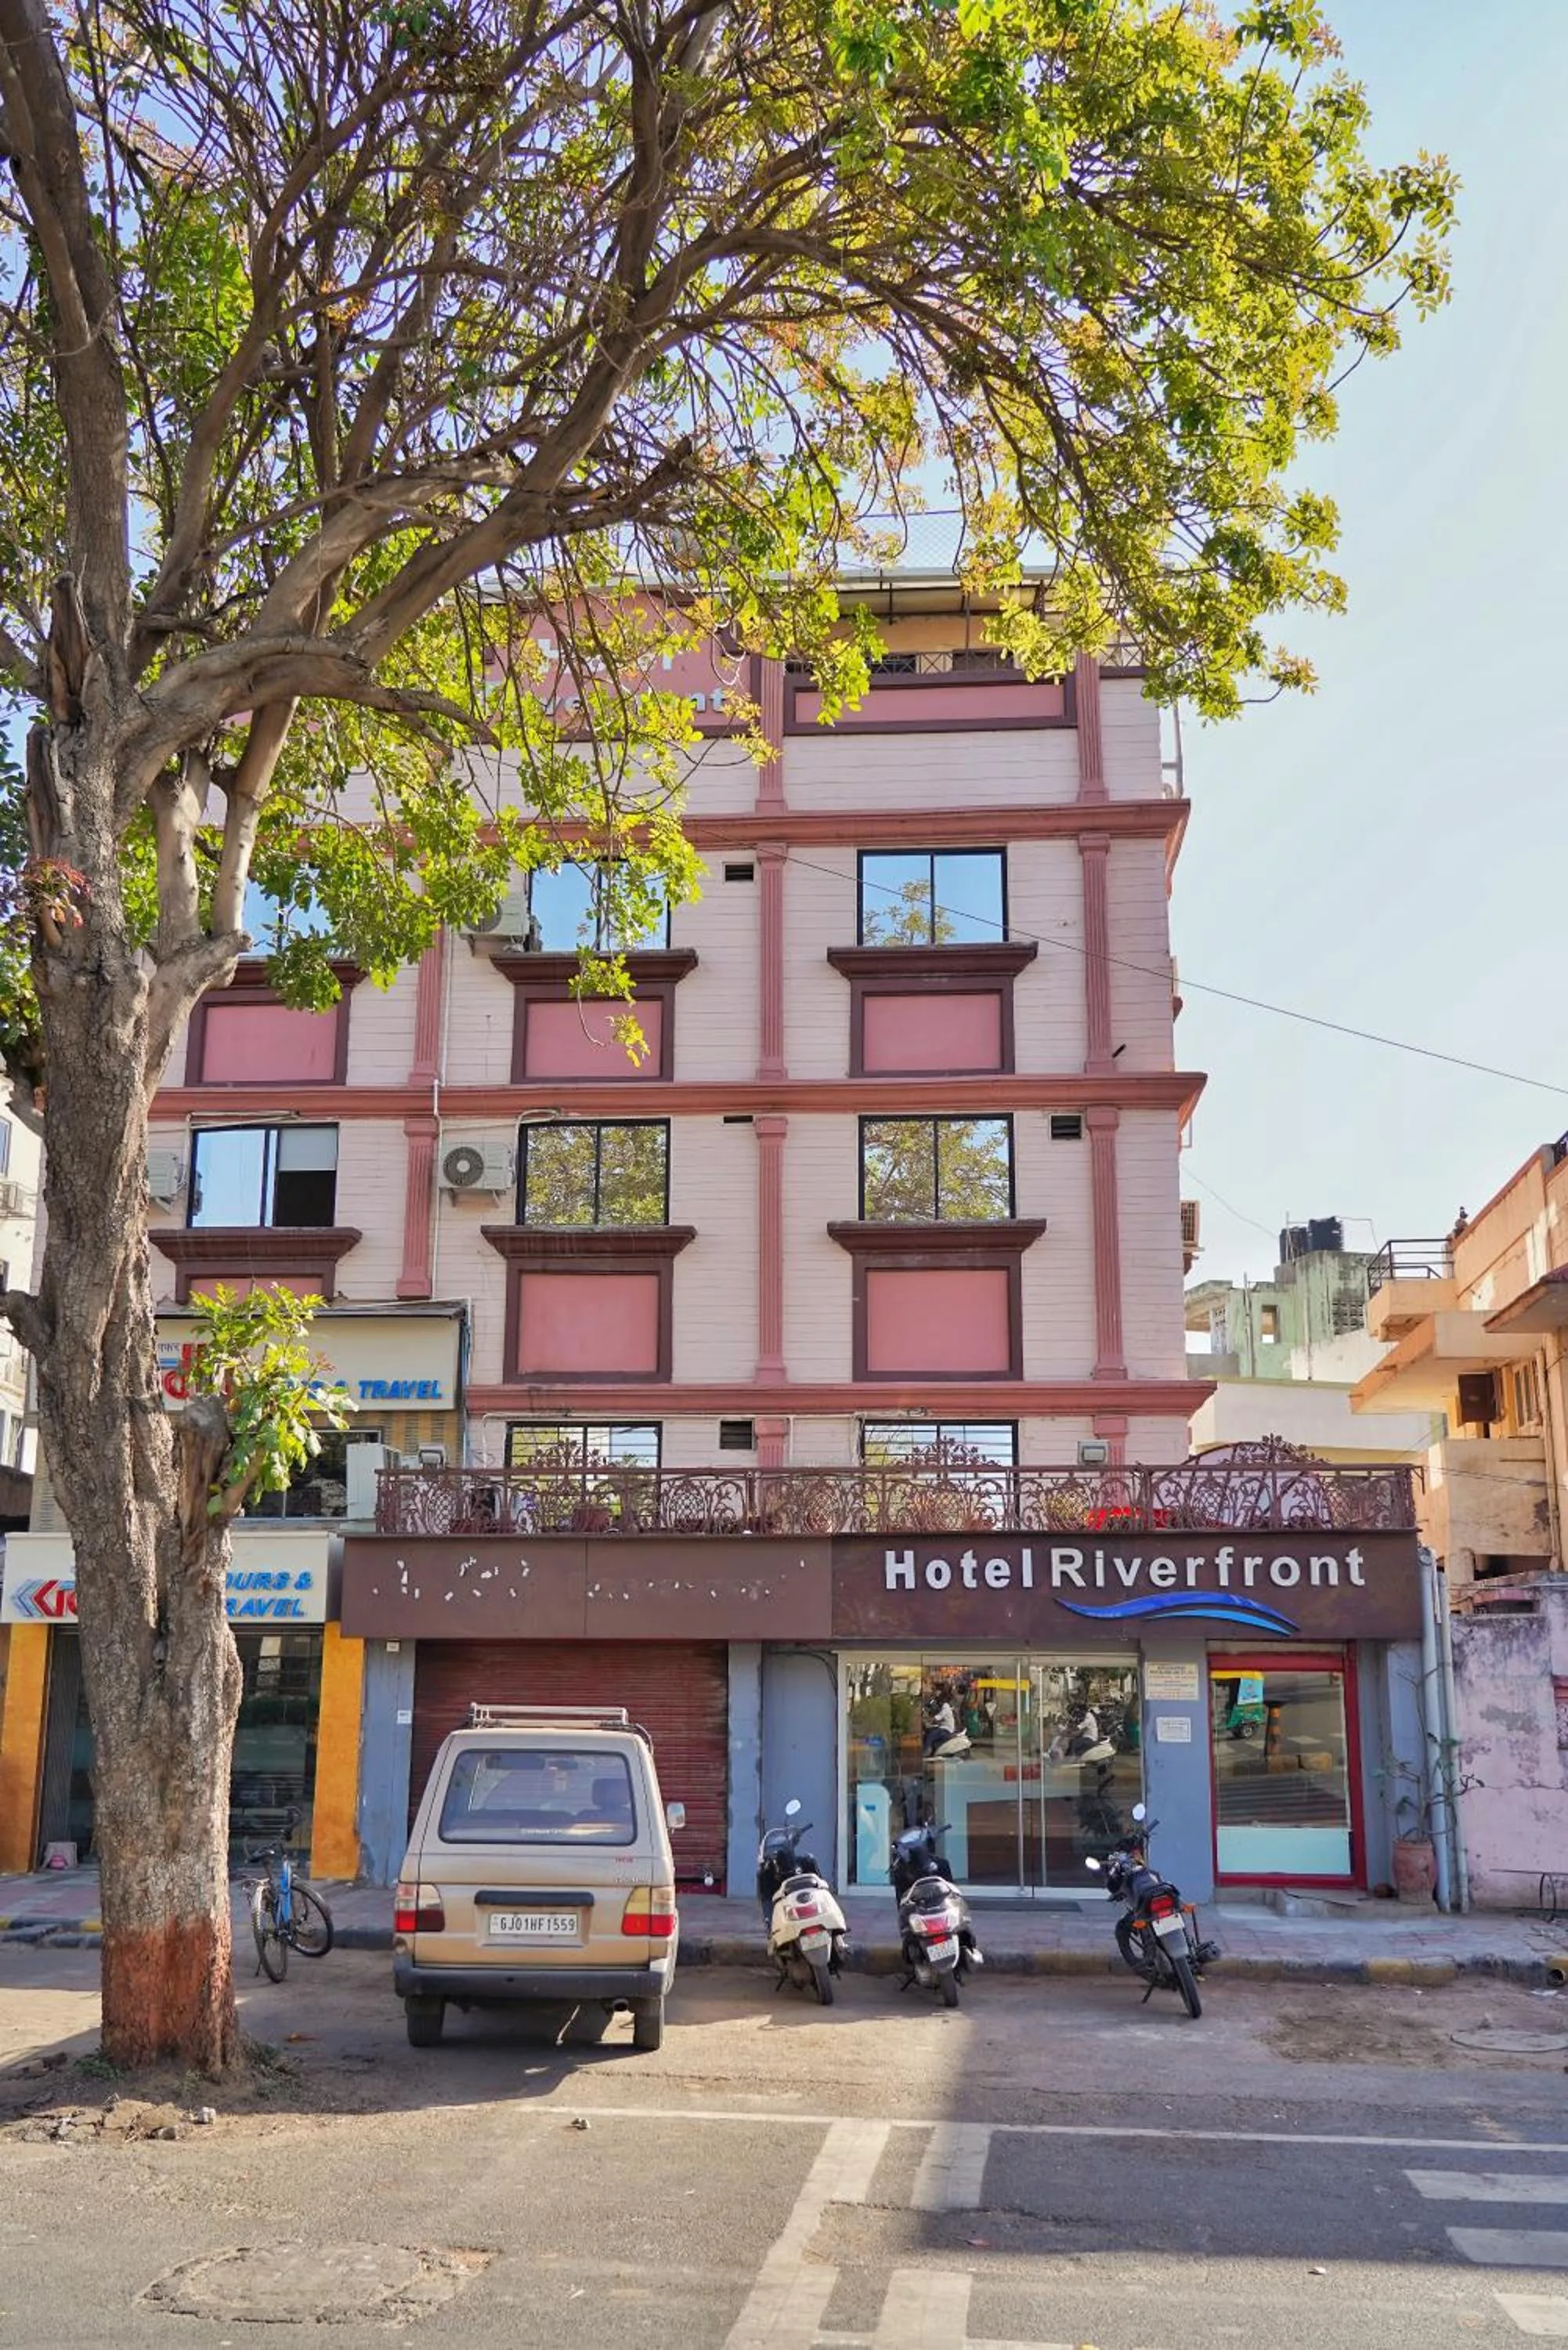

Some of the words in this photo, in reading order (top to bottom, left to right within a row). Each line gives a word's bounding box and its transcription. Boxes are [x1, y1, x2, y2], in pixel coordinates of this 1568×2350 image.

[359, 1379, 442, 1399] TRAVEL
[885, 1548, 1033, 1589] Hotel
[1051, 1546, 1366, 1587] Riverfront
[226, 1572, 291, 1591] URS
[294, 1571, 312, 1590] &
[226, 1598, 305, 1617] RAVEL
[500, 1917, 576, 1931] GJ01HF1559
